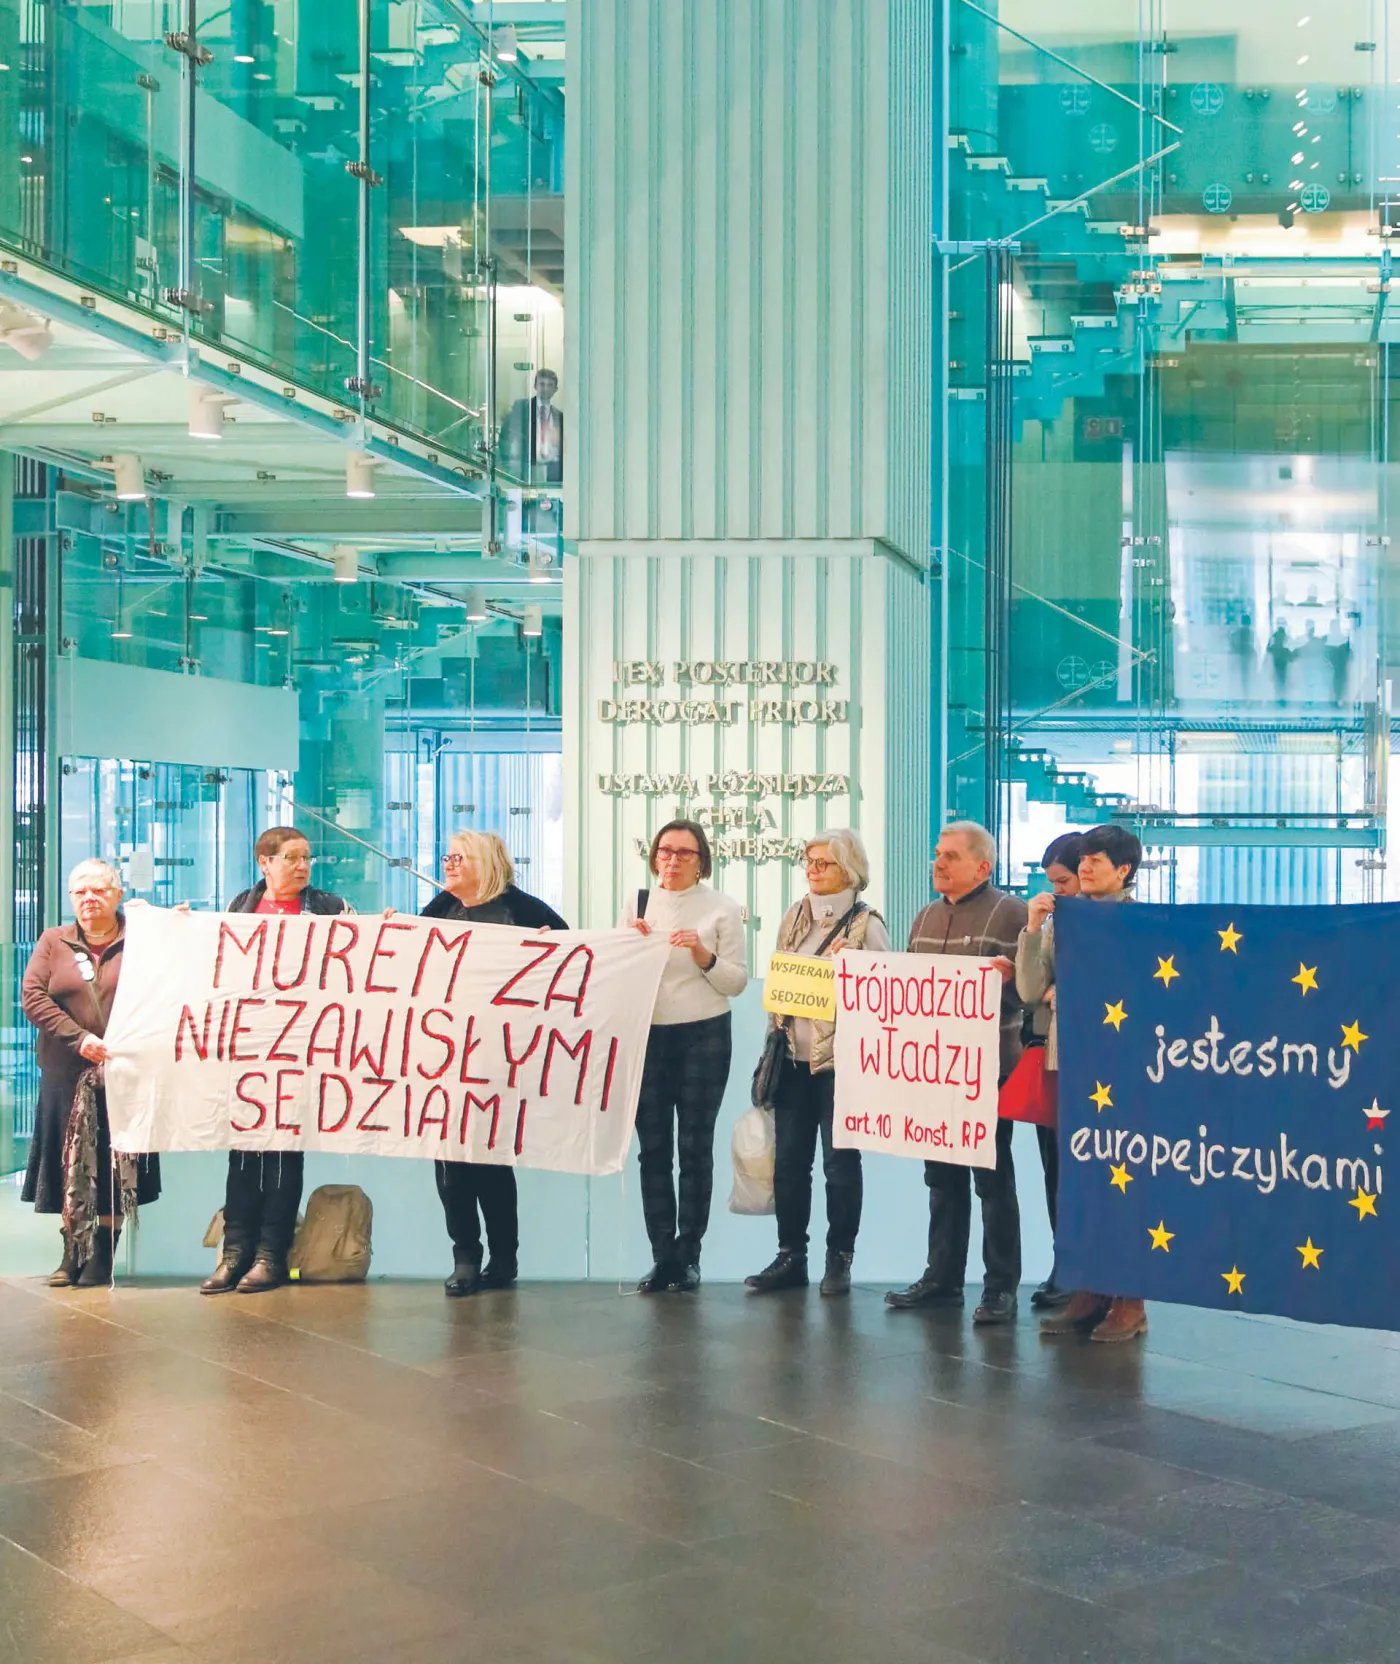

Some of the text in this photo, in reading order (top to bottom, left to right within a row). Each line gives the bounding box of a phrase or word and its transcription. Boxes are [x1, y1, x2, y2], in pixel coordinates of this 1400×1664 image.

[673, 660, 835, 685] POSTERIOR
[597, 699, 848, 722] DEROGAT PRIORI
[596, 773, 696, 794] USTAWA
[213, 918, 594, 1017] MUREM ZA
[770, 960, 836, 980] WSPIERAM
[838, 958, 996, 1024] trójpodział
[770, 988, 830, 1008] SĘDZIÓW
[175, 998, 618, 1112] NIEZAWISŁYMI
[860, 1026, 982, 1101] władzy
[230, 1068, 527, 1156] SĘDZIAMI
[904, 1116, 953, 1149] Konst.
[961, 1120, 987, 1150] RP
[1070, 1124, 1384, 1195] europejczykami
